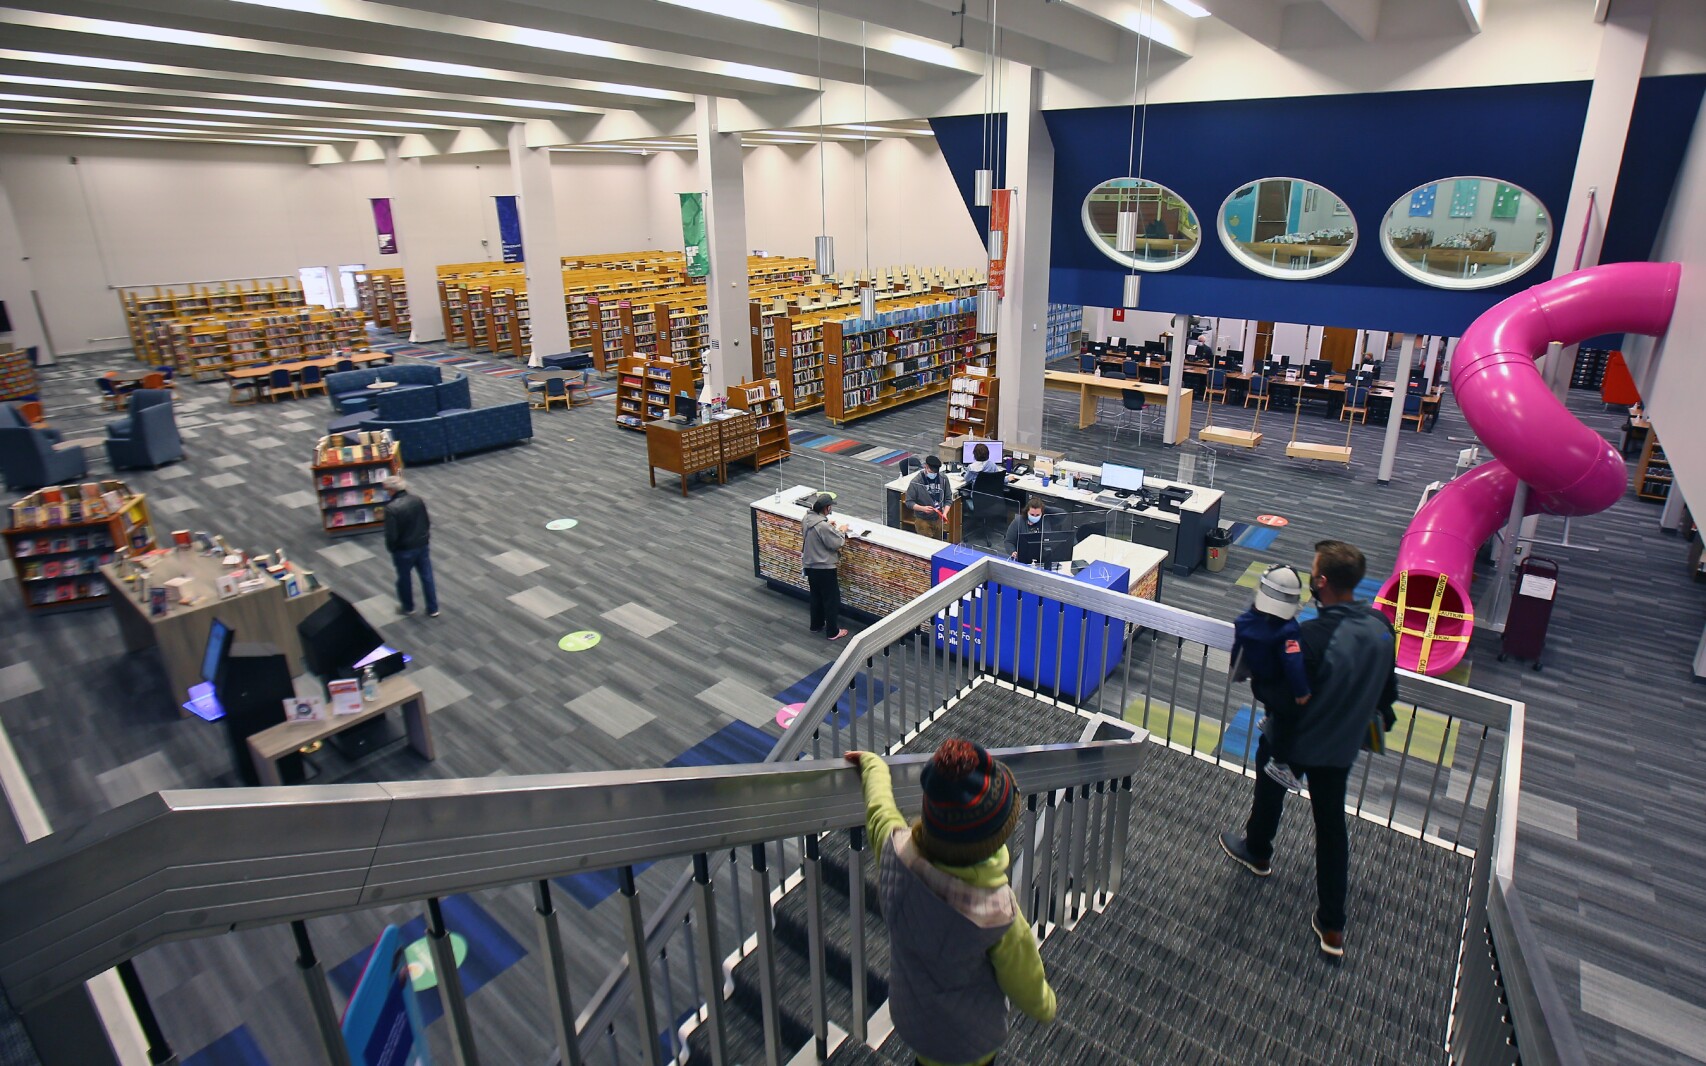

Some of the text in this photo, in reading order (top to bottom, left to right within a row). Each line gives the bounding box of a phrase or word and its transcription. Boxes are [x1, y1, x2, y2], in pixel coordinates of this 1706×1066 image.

[1436, 575, 1447, 597] CAUTION
[1440, 611, 1463, 619] AUTION
[962, 632, 981, 645] Foks
[1417, 659, 1427, 675] CAUT
